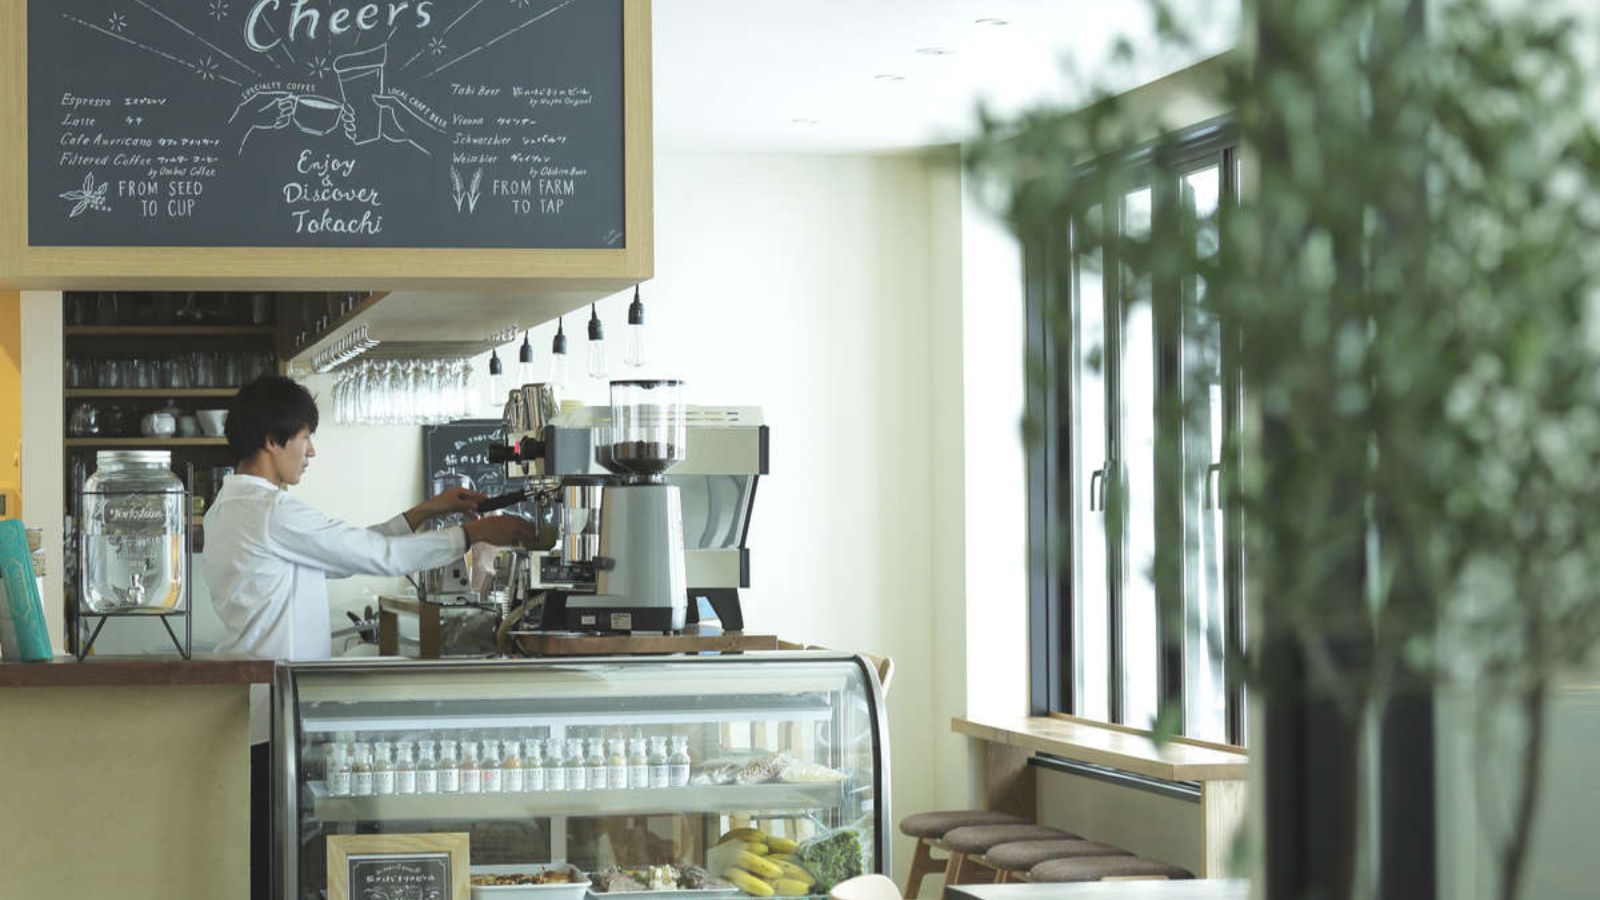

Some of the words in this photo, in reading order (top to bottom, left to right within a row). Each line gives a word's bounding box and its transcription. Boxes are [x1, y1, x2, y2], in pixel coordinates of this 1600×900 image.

[244, 0, 434, 52] Cheers
[241, 82, 286, 100] SPECIALTY
[287, 82, 316, 92] COFFEE
[387, 87, 409, 103] LOCAL
[61, 92, 112, 110] Espresso
[61, 113, 96, 126] Latte
[93, 132, 153, 147] Americano
[60, 151, 109, 167] Filtered
[113, 153, 152, 167] Coffee
[297, 149, 356, 177] Enjoy
[148, 167, 158, 180] by
[190, 166, 217, 177] Coffee
[529, 166, 538, 178] by
[118, 180, 158, 197] FROM
[169, 180, 203, 197] SEED
[321, 175, 334, 187] &
[493, 179, 532, 196] FROM
[539, 179, 575, 196] FARM
[283, 182, 382, 206] Discover
[141, 199, 158, 217] TO
[168, 199, 196, 217] CUP
[512, 199, 531, 214] TO
[540, 199, 565, 214] TAP
[291, 208, 383, 235] Tokachi
